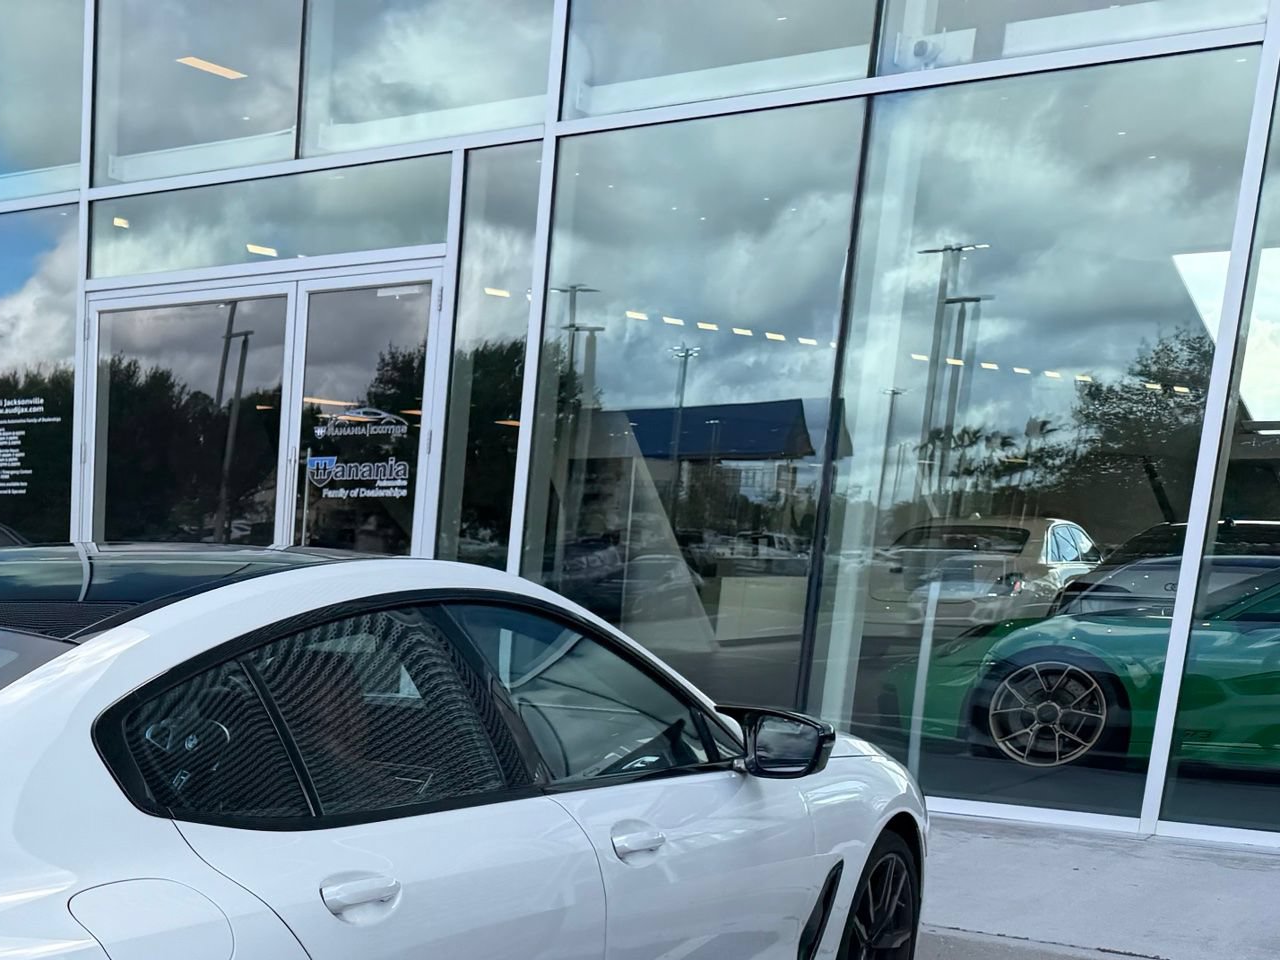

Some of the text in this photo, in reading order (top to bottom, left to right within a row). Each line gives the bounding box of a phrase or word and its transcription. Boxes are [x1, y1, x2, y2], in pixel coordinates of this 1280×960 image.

[4, 397, 44, 407] Jacksonville
[322, 488, 408, 499] Family of Dealerships
